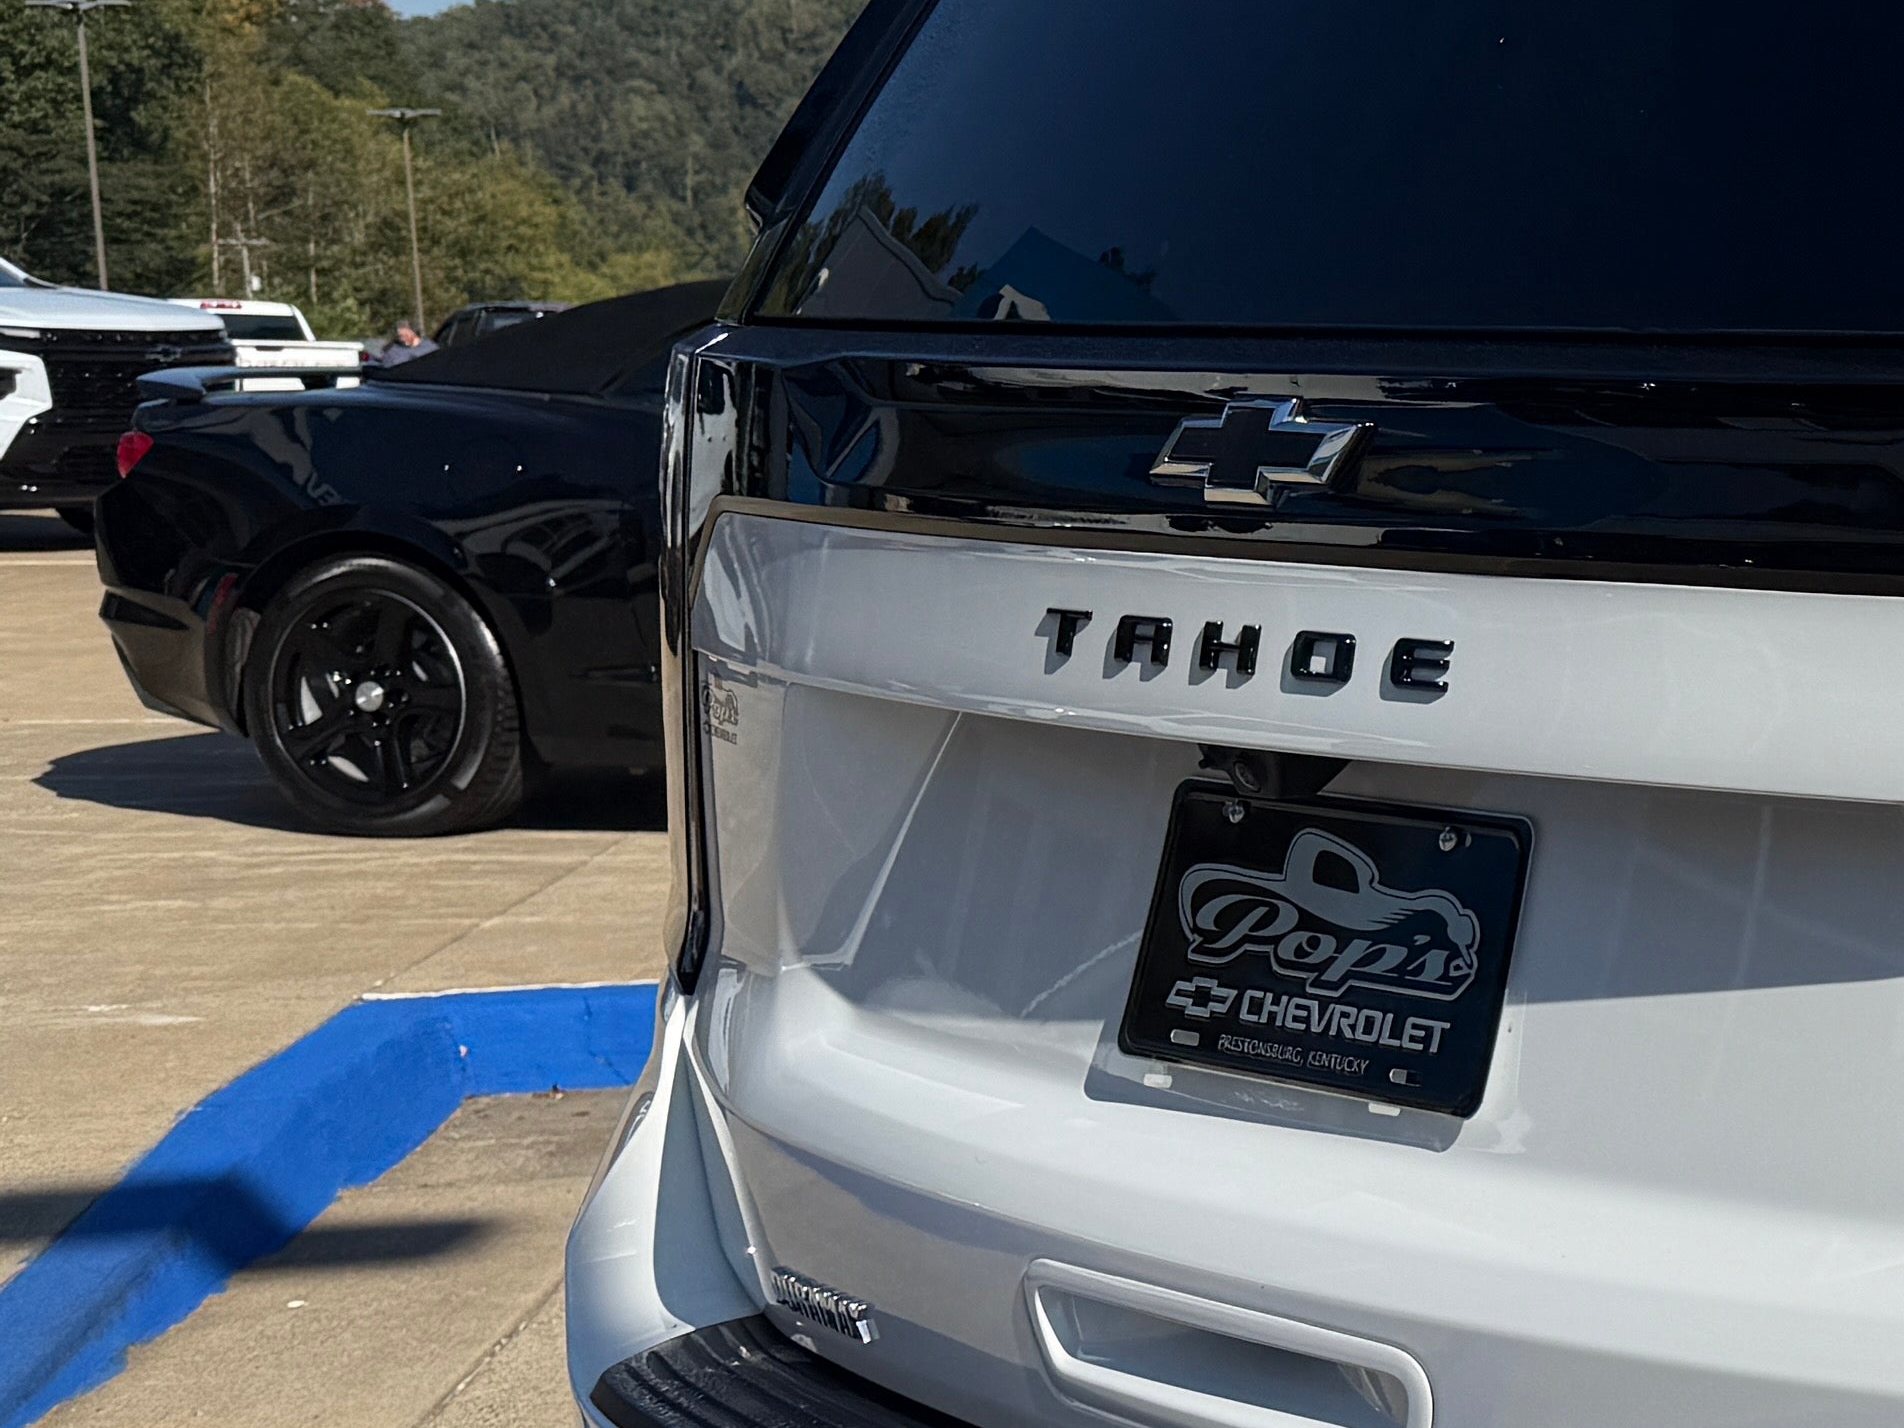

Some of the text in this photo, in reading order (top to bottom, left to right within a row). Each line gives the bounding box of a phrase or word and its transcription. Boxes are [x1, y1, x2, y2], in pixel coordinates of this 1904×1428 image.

[1044, 605, 1456, 694] TAHOE
[1196, 894, 1453, 986] Pop's
[1217, 1034, 1370, 1074] PRESTONSBURG, KENTUCKY
[1239, 989, 1451, 1054] CHEVROLET
